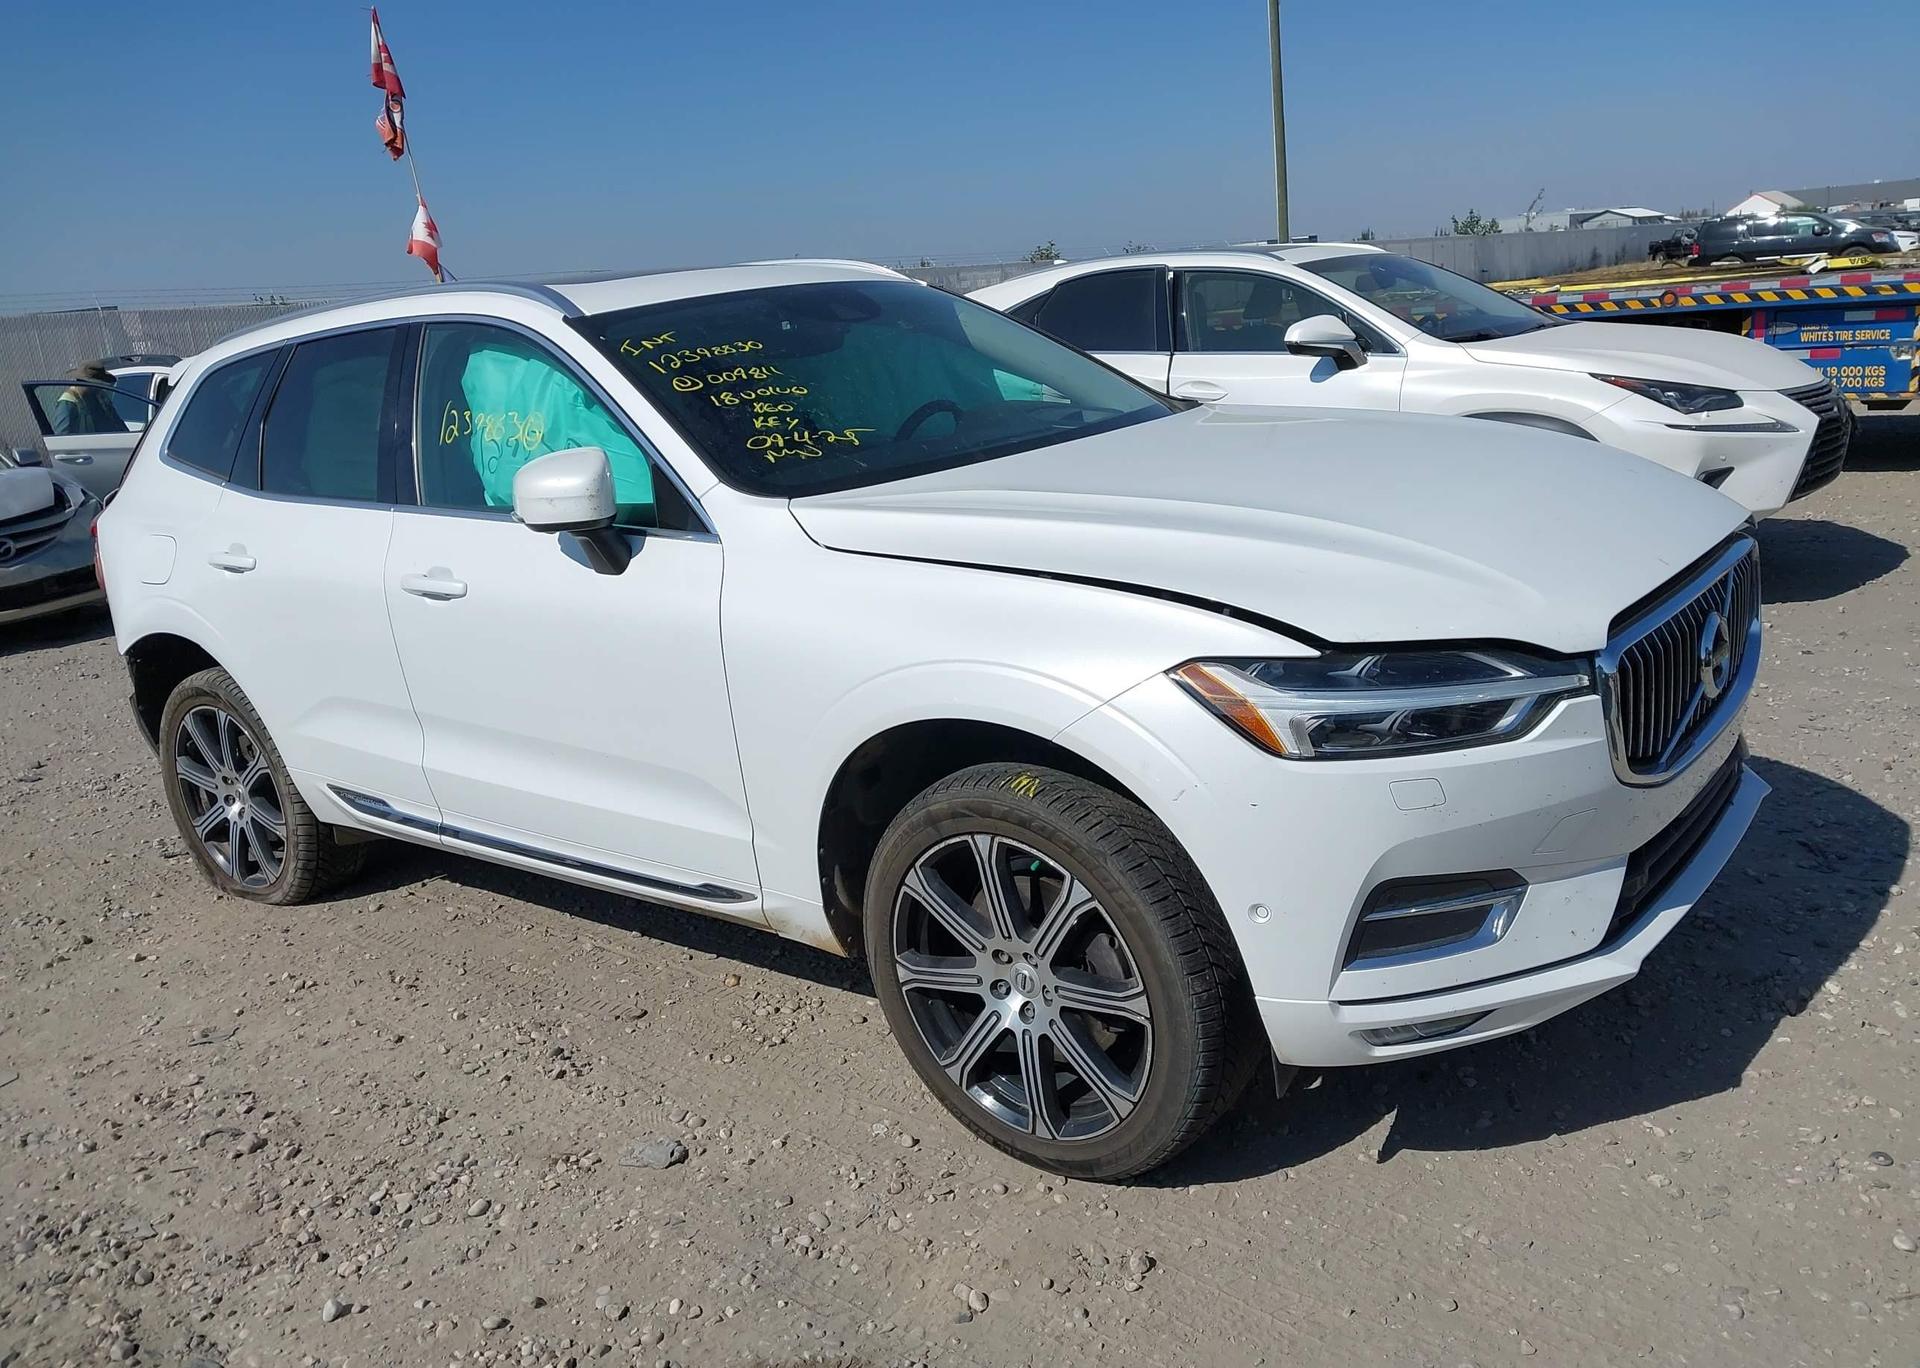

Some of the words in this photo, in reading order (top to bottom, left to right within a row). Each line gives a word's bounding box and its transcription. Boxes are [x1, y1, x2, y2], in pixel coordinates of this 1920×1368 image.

[1835, 331, 1853, 340] TIRE
[1855, 329, 1891, 340] SERVICE
[1864, 366, 1886, 376] KGS
[1864, 377, 1885, 387] KGS
[753, 417, 799, 430] KEY
